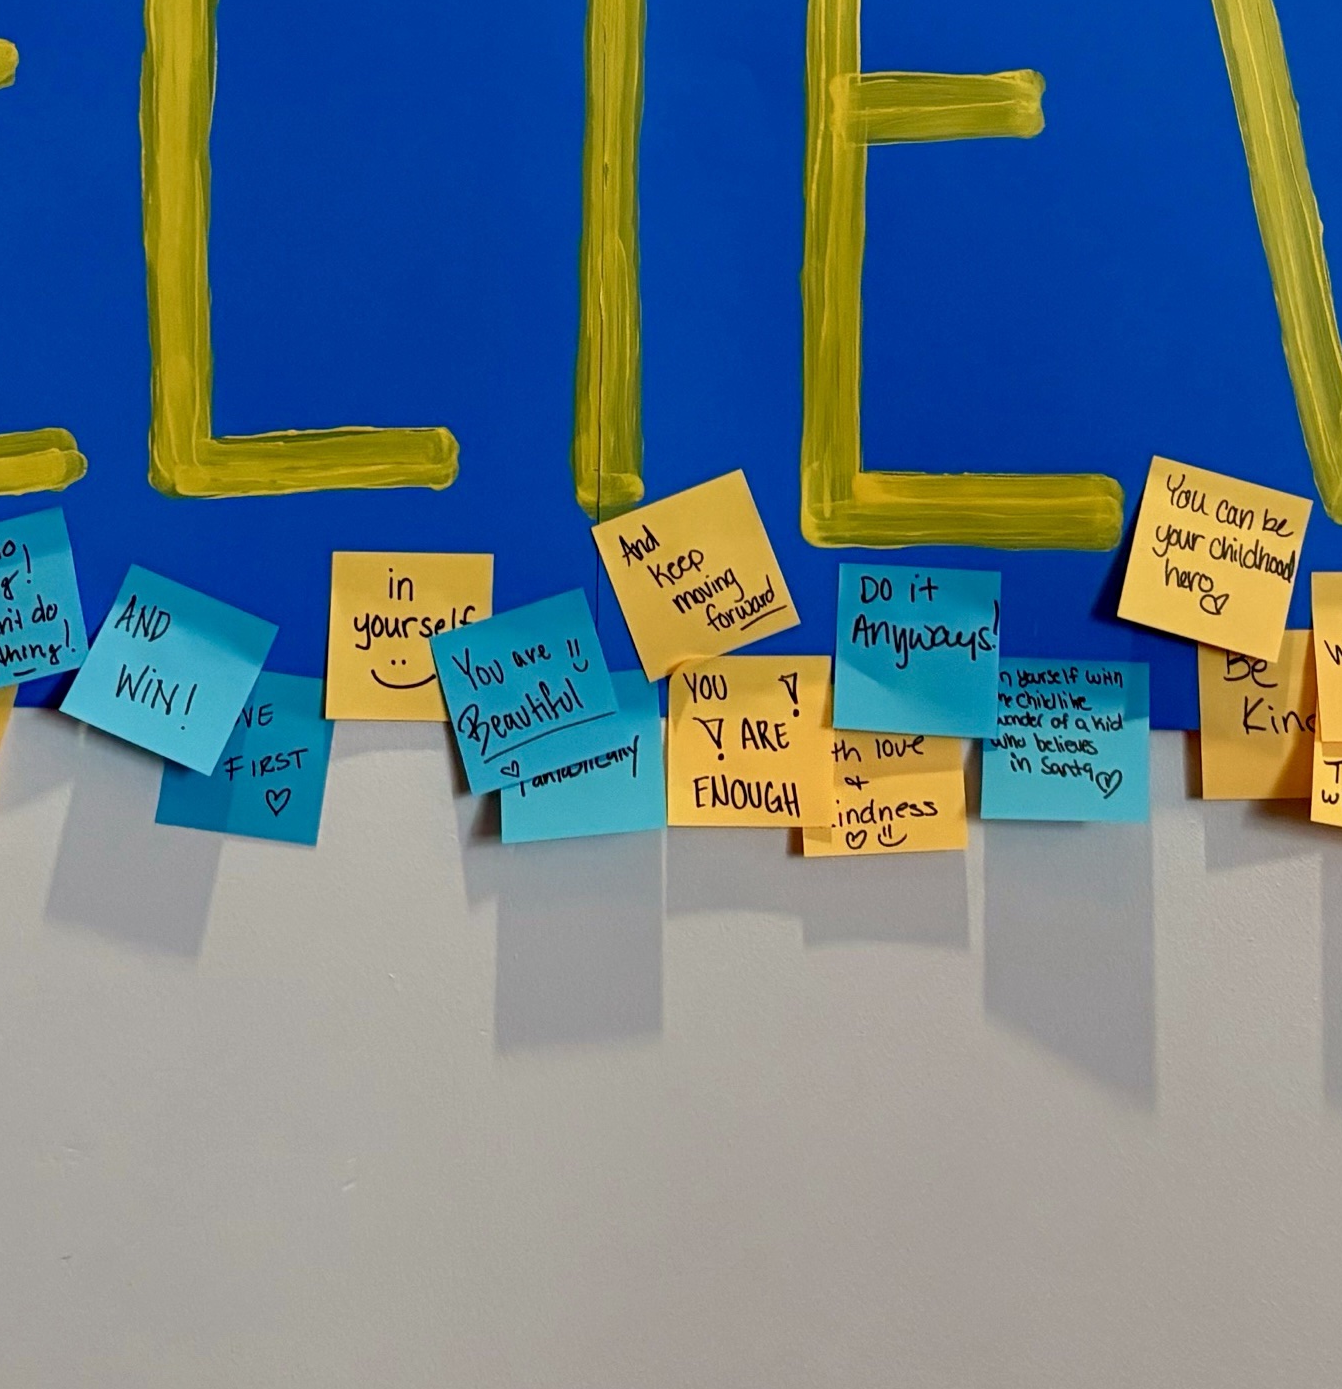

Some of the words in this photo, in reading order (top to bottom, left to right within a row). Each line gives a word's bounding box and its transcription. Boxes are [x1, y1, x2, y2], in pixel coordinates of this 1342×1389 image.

[1167, 473, 1207, 515] You
[1216, 500, 1254, 529] can
[619, 525, 659, 567] And
[1153, 521, 1205, 557] your
[1210, 537, 1297, 583] childhood
[672, 567, 744, 615] moving
[1165, 559, 1214, 592] hero
[115, 594, 171, 642] AND
[354, 605, 476, 649] yourself
[707, 575, 775, 632] forward
[453, 647, 504, 692] You
[512, 644, 552, 667] are
[683, 673, 728, 704] YOU
[116, 664, 198, 731] WIN!
[459, 678, 583, 756] Beautiful
[741, 722, 790, 752] ARE
[223, 748, 309, 782] FIRST
[692, 775, 800, 818] ENOUGH
